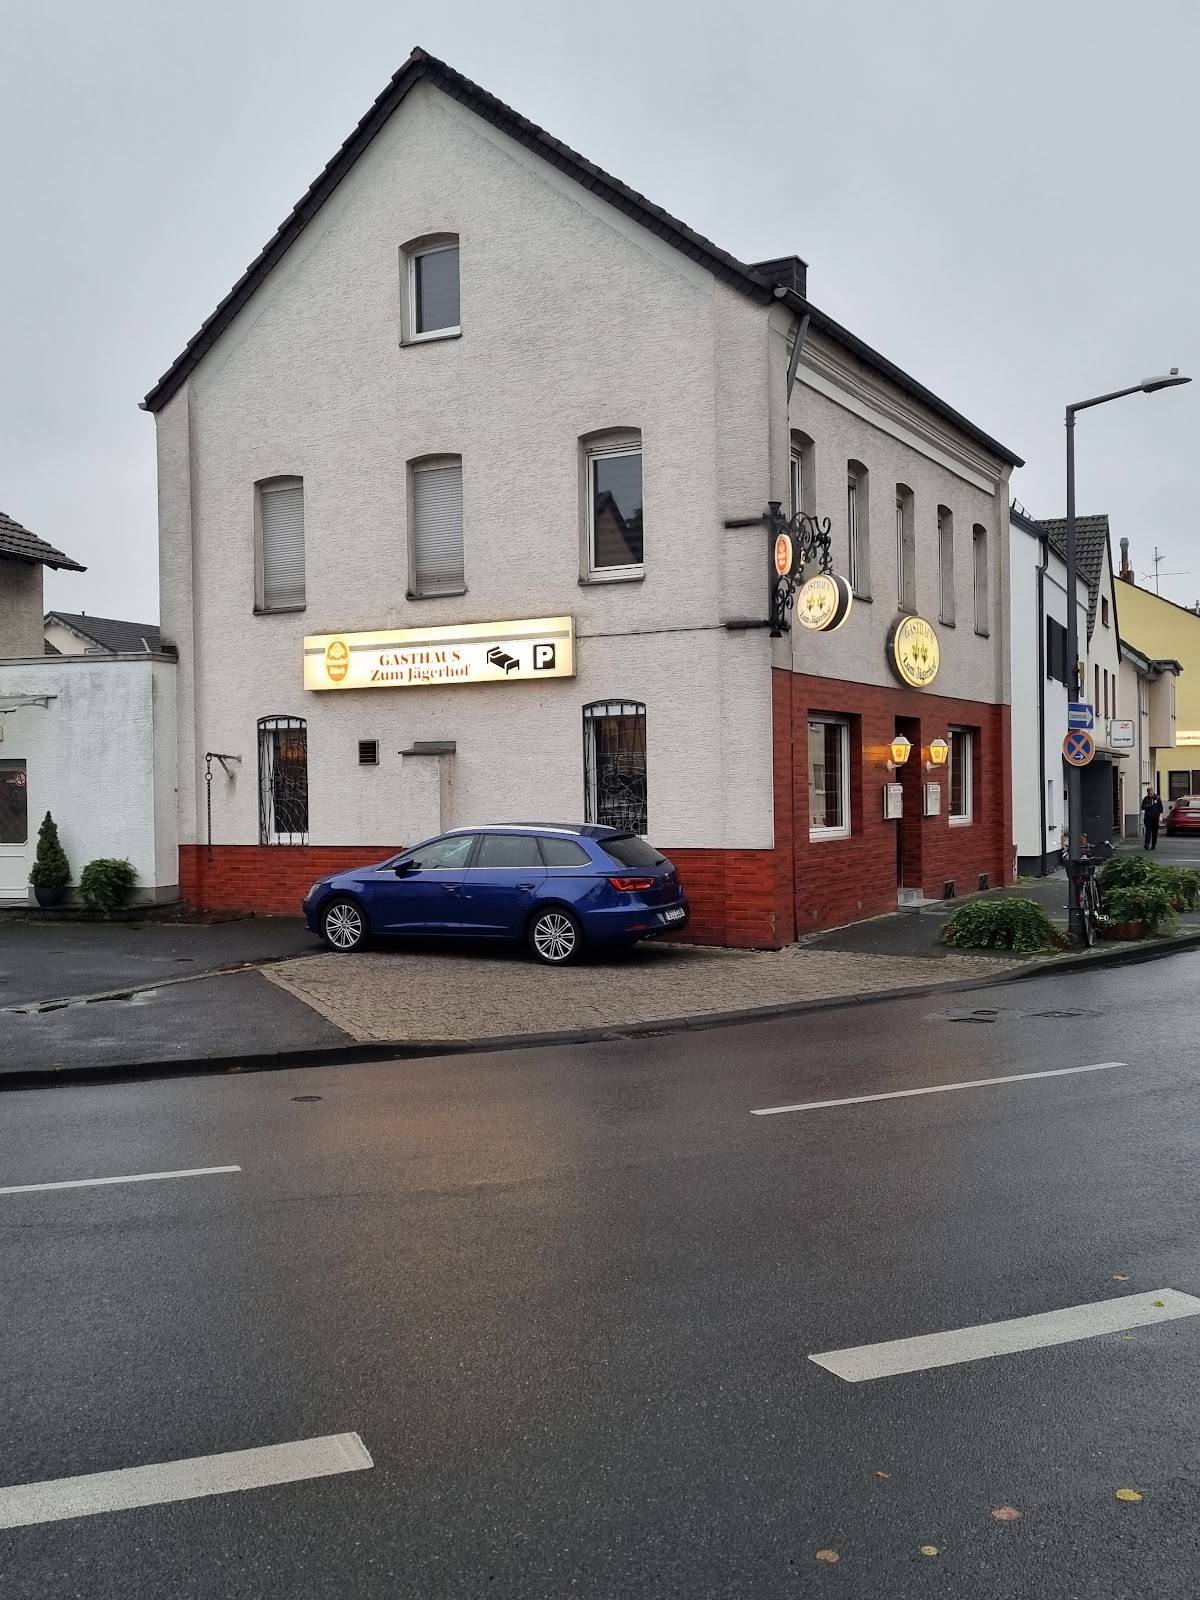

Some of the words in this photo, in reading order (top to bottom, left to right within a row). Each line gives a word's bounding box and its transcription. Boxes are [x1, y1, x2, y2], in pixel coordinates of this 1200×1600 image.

[379, 650, 461, 667] GASTHAUS
[536, 645, 554, 668] P
[370, 667, 404, 682] Zum
[408, 663, 471, 683] Jägerhof
